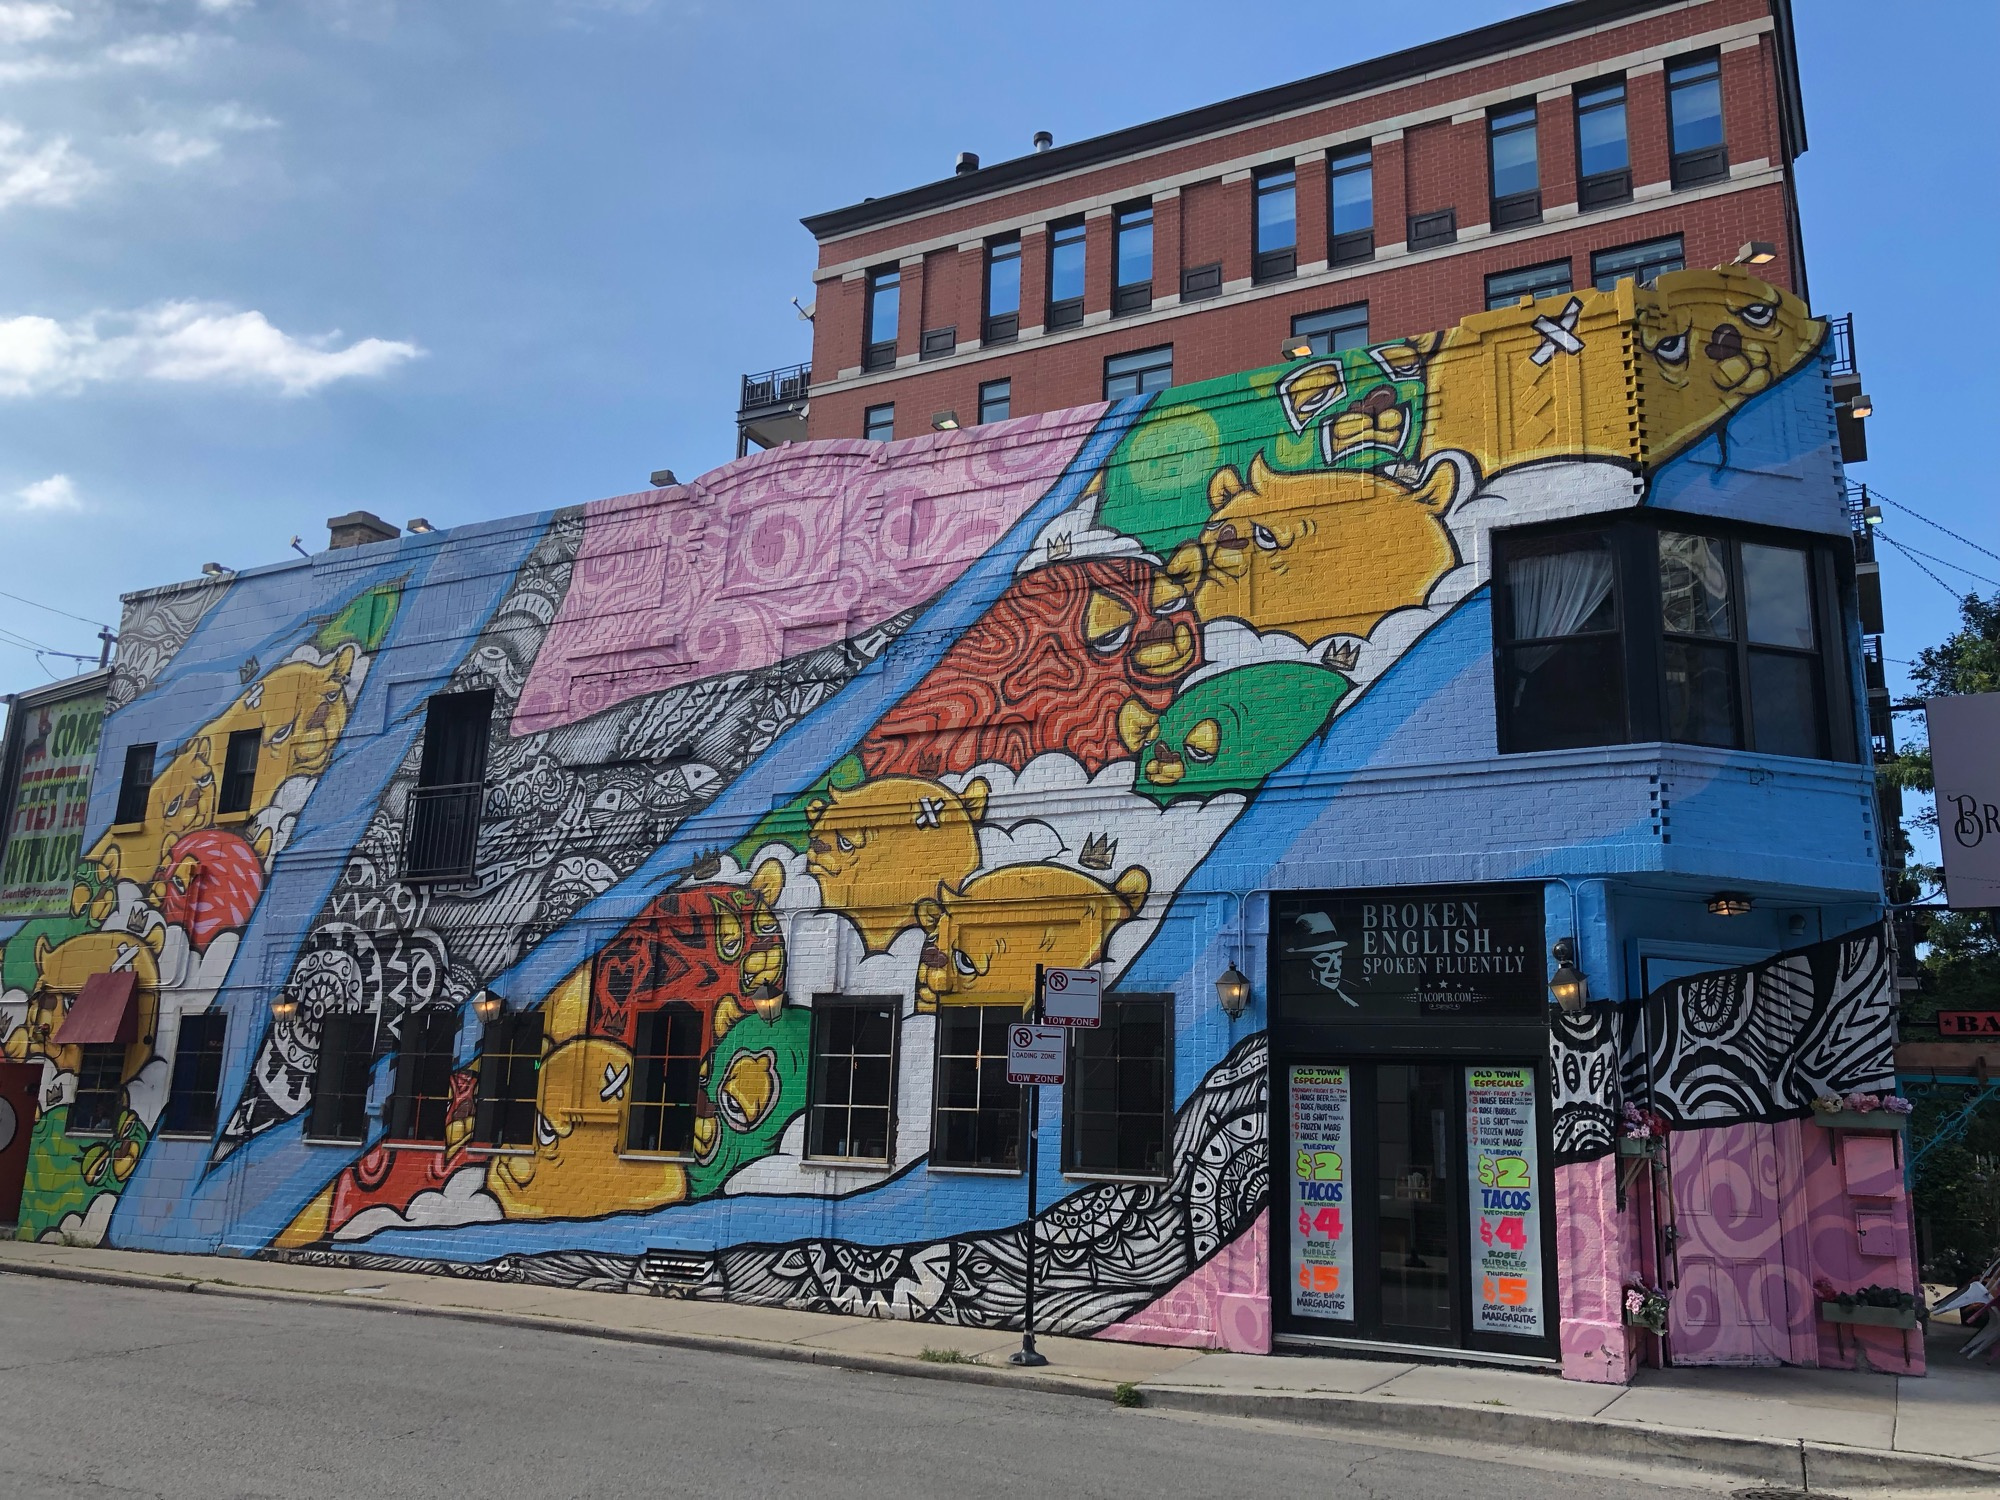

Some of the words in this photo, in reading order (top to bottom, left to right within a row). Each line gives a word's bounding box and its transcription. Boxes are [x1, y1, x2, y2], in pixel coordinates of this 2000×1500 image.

[52, 711, 104, 758] COME
[12, 764, 90, 834] FIESTA
[1362, 902, 1478, 929] BROKEN
[1362, 928, 1525, 955] ENGLISH...
[1362, 956, 1428, 975] SPOKEN
[1436, 955, 1525, 974] FLUENTLY
[1417, 992, 1472, 1003] TACOPUB.COM
[1047, 1016, 1066, 1025] TOW
[1070, 1017, 1095, 1027] ZONE
[1012, 1051, 1038, 1059] LOADING
[1296, 1068, 1314, 1076] OLD
[1474, 1070, 1492, 1078] OLD
[1495, 1070, 1520, 1078] TOWN
[1011, 1073, 1031, 1082] TOW
[1034, 1075, 1060, 1084] ZONE
[1300, 1093, 1315, 1101] HOUSE
[1317, 1094, 1330, 1102] BEER
[1480, 1096, 1497, 1105] HOUSE
[1498, 1097, 1514, 1105] BEER
[1313, 1113, 1328, 1121] SHOT
[1493, 1118, 1510, 1126] SHOT
[1301, 1123, 1322, 1131] FROZEN
[1324, 1123, 1341, 1132] MARG
[1480, 1127, 1503, 1136] FROZEN
[1505, 1128, 1524, 1136] MARG
[1300, 1132, 1318, 1140] HOUSE
[1322, 1132, 1340, 1141] MARG
[1480, 1138, 1500, 1146] HOUSE
[1502, 1138, 1523, 1146] MARG
[1303, 1143, 1336, 1151] TUESDAY
[1296, 1149, 1343, 1181] $2
[1478, 1154, 1531, 1188] $2
[1299, 1182, 1343, 1202] TACOS
[1481, 1189, 1532, 1211] TACOS
[1483, 1209, 1526, 1217] WEDNESDAY
[1298, 1207, 1344, 1240] $4
[1479, 1216, 1528, 1250] $4
[1302, 1248, 1337, 1256] BUBBLES
[1482, 1258, 1527, 1268] BUBBLES
[1298, 1263, 1340, 1292] $5
[1486, 1270, 1523, 1278] THURSDAY
[1482, 1275, 1528, 1306] $5
[1296, 1297, 1346, 1310] MARGARITAS
[1482, 1303, 1505, 1311] BASIC
[1481, 1311, 1537, 1325] MARGARITAS
